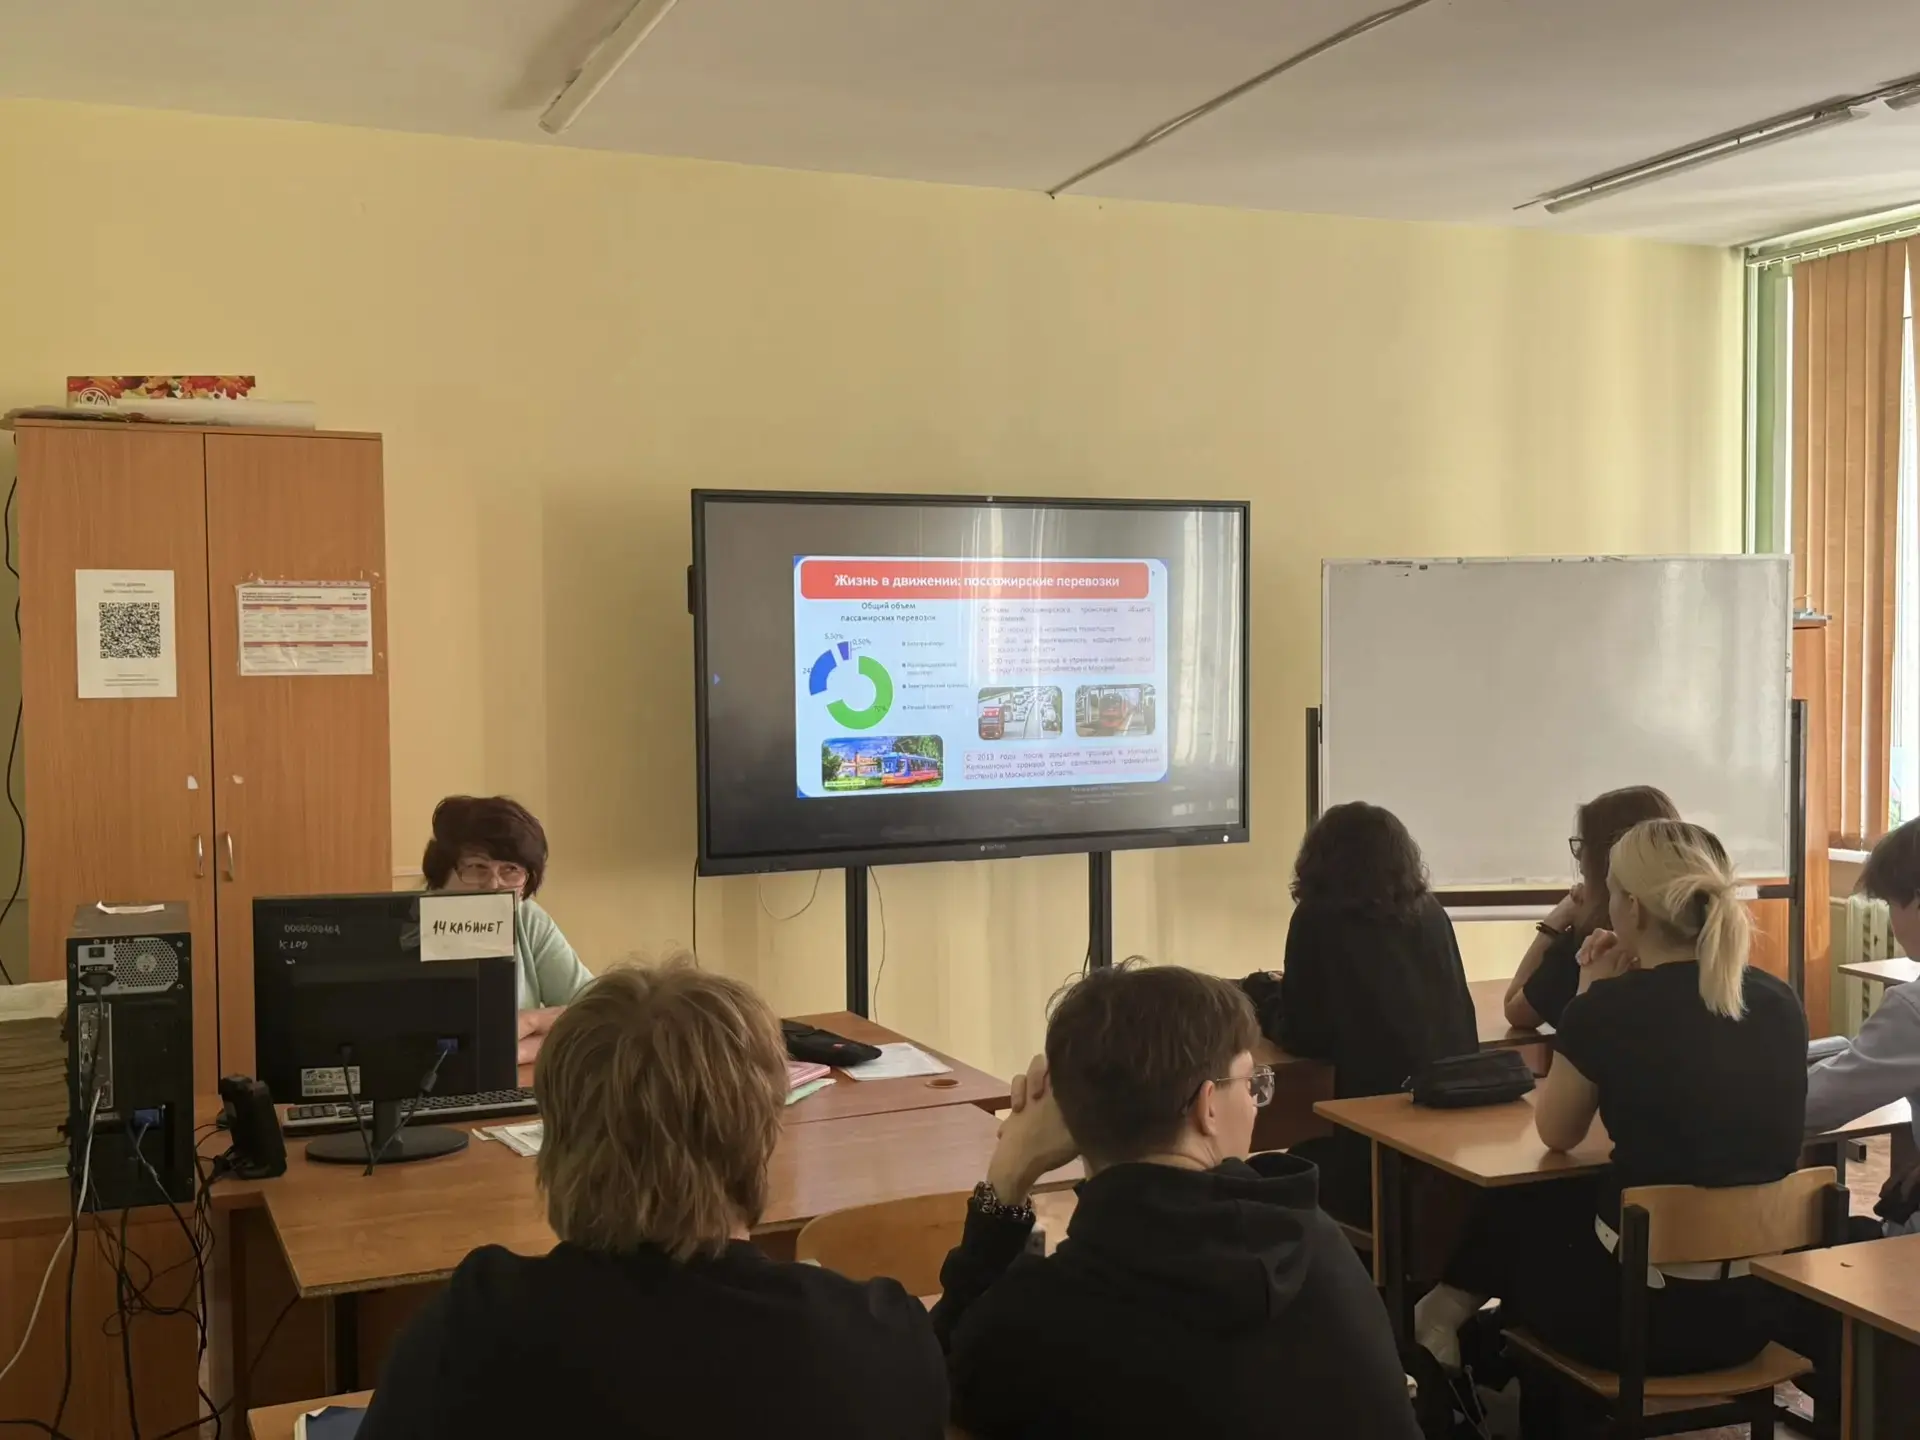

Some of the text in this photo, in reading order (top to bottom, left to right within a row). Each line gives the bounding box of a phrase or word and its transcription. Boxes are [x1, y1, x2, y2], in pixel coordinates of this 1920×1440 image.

[834, 574, 1120, 588] Жизнь в движении: пассажирские перевозки
[861, 601, 916, 611] Общий объем
[840, 614, 895, 623] пассажирских
[852, 638, 872, 646] 0,50%
[432, 919, 504, 936] 14 КАБИНЕТ
